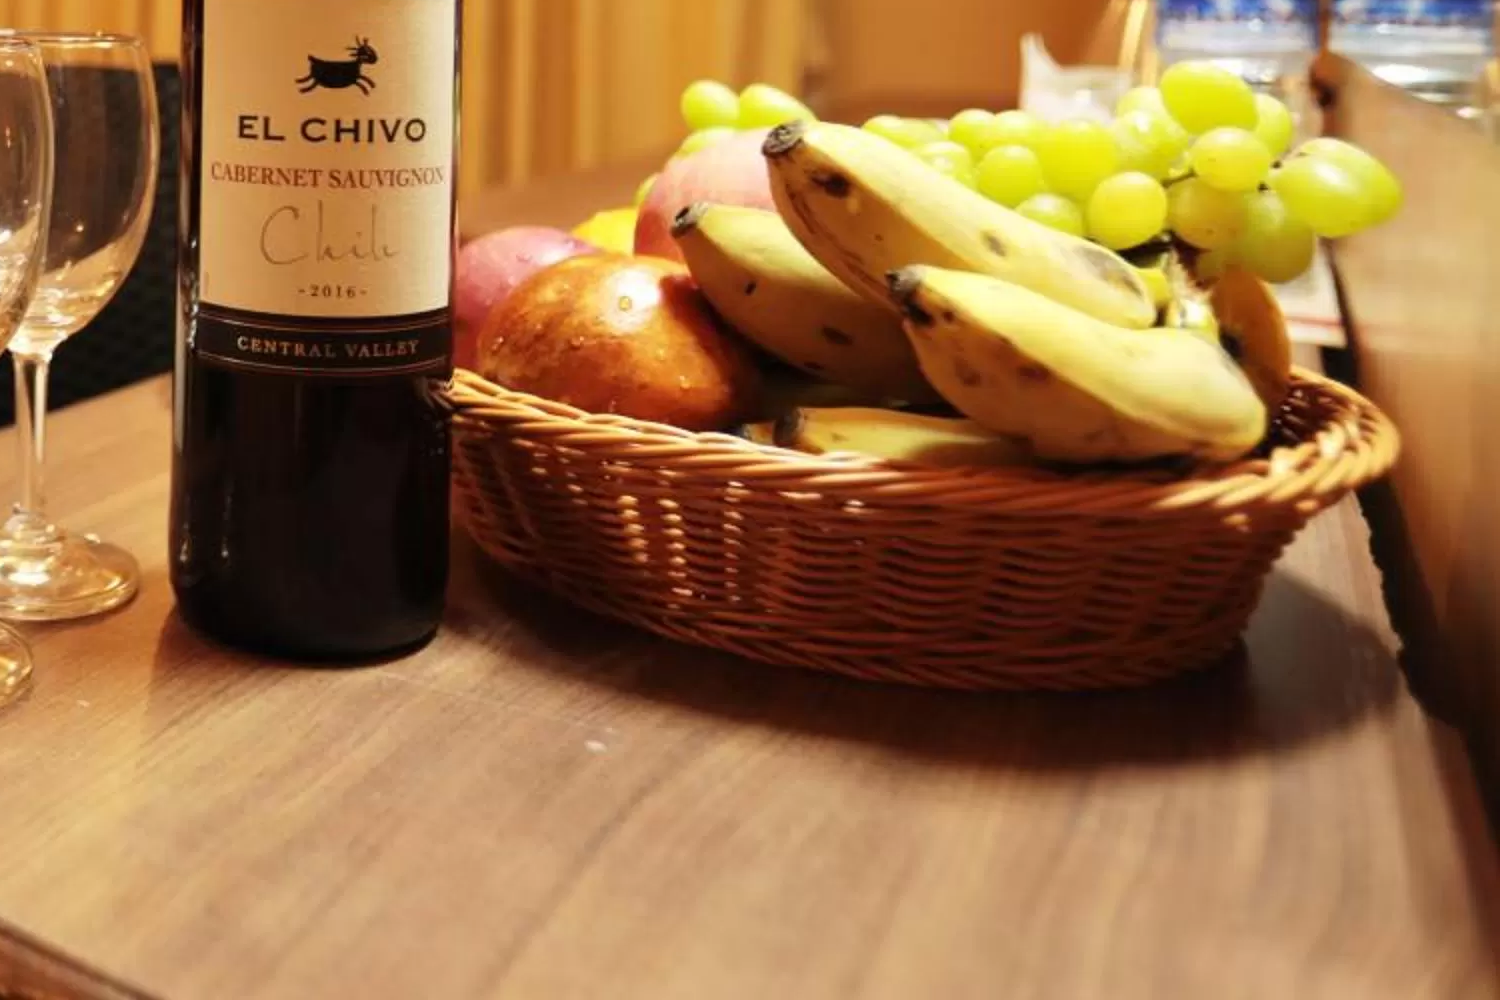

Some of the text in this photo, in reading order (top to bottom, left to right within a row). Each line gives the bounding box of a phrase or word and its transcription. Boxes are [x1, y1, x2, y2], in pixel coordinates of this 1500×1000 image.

[238, 115, 426, 143] EL CHIVO
[211, 162, 445, 189] CABERNET SAUVIGNON
[237, 335, 419, 358] CENTRAL VALLEY
